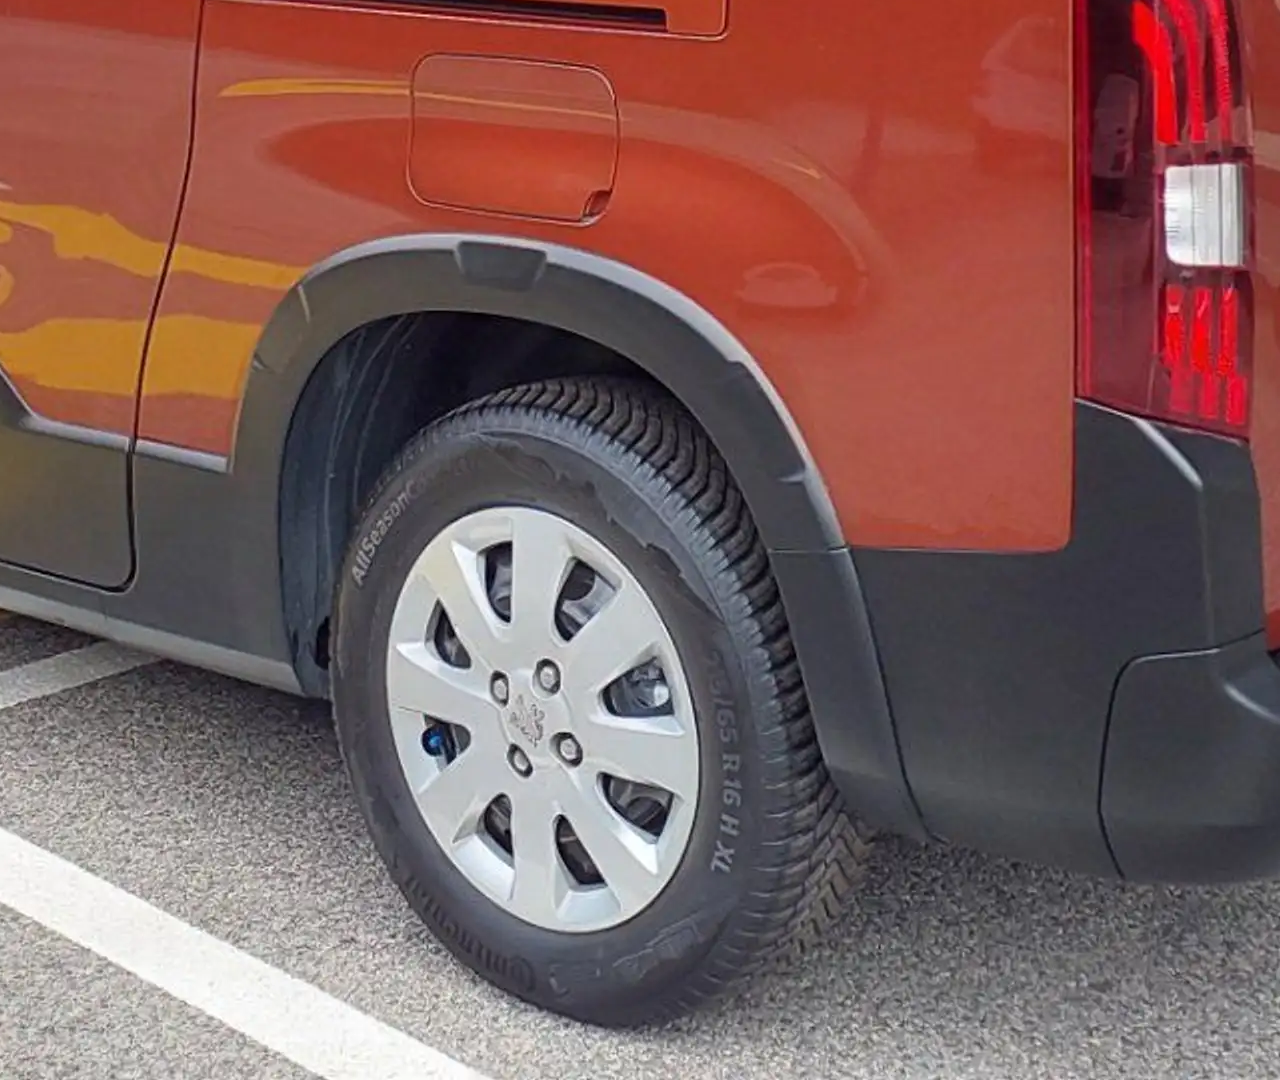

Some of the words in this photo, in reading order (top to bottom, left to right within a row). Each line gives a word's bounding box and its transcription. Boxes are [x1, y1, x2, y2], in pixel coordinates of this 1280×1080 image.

[722, 752, 741, 772] R
[722, 777, 742, 807] 16
[718, 812, 740, 837] H
[710, 840, 735, 874] XL
